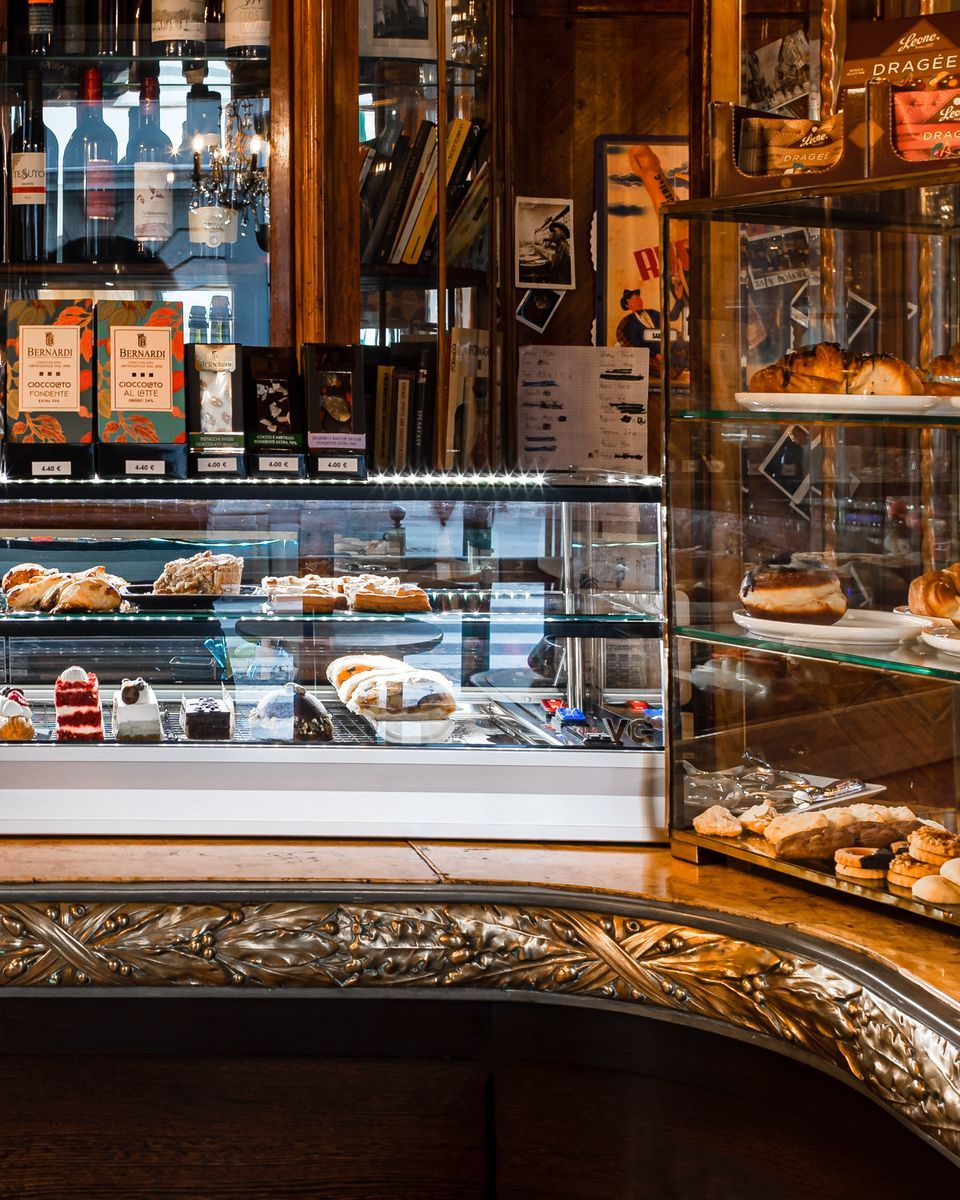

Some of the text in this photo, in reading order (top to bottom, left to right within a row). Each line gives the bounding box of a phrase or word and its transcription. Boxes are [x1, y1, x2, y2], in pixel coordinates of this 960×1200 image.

[897, 33, 936, 52] Leone
[873, 54, 958, 76] DRAGÉE
[27, 347, 73, 357] BERNARDI
[119, 348, 166, 358] BERNARDI
[27, 381, 72, 389] CIOCCOLATO
[119, 381, 164, 389] CIOCCOLATO
[29, 390, 70, 398] FONDENTE
[123, 389, 159, 398] AL LATTE
